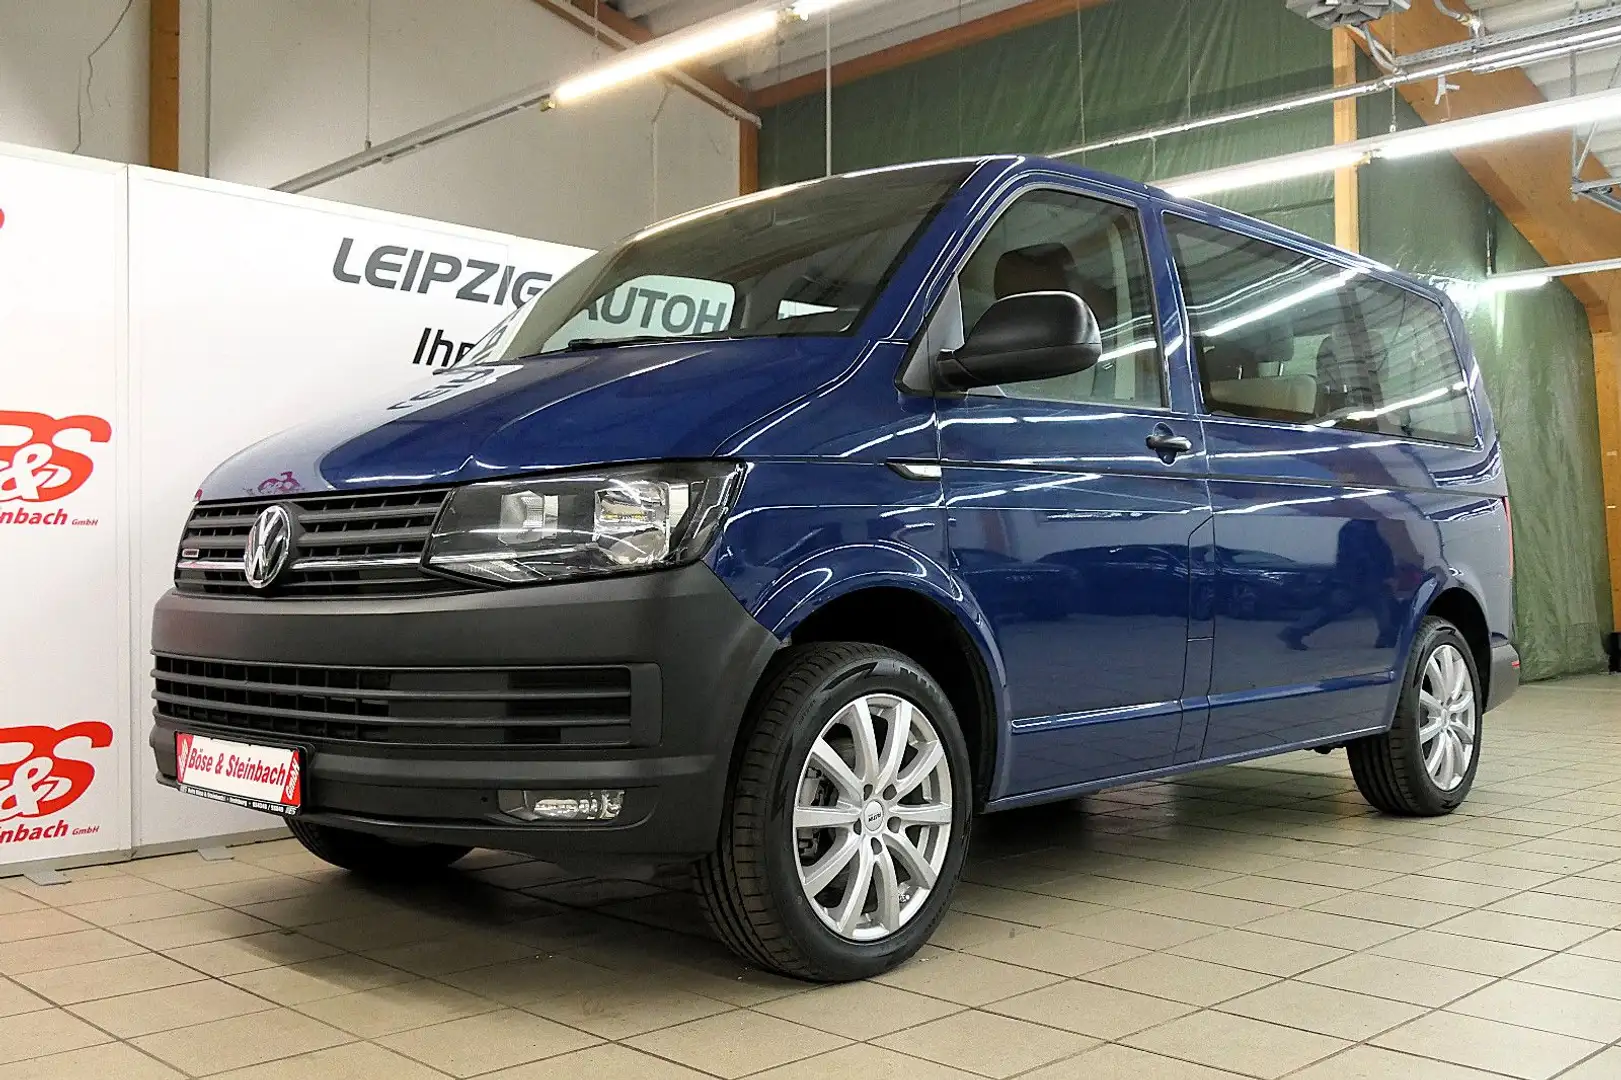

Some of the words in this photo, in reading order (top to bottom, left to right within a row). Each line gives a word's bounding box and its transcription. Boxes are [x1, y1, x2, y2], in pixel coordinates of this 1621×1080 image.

[71, 518, 98, 526] GmbH
[188, 747, 213, 773] Böse
[215, 752, 225, 775] &
[226, 754, 287, 786] Steinbach
[72, 826, 99, 835] GmbH
